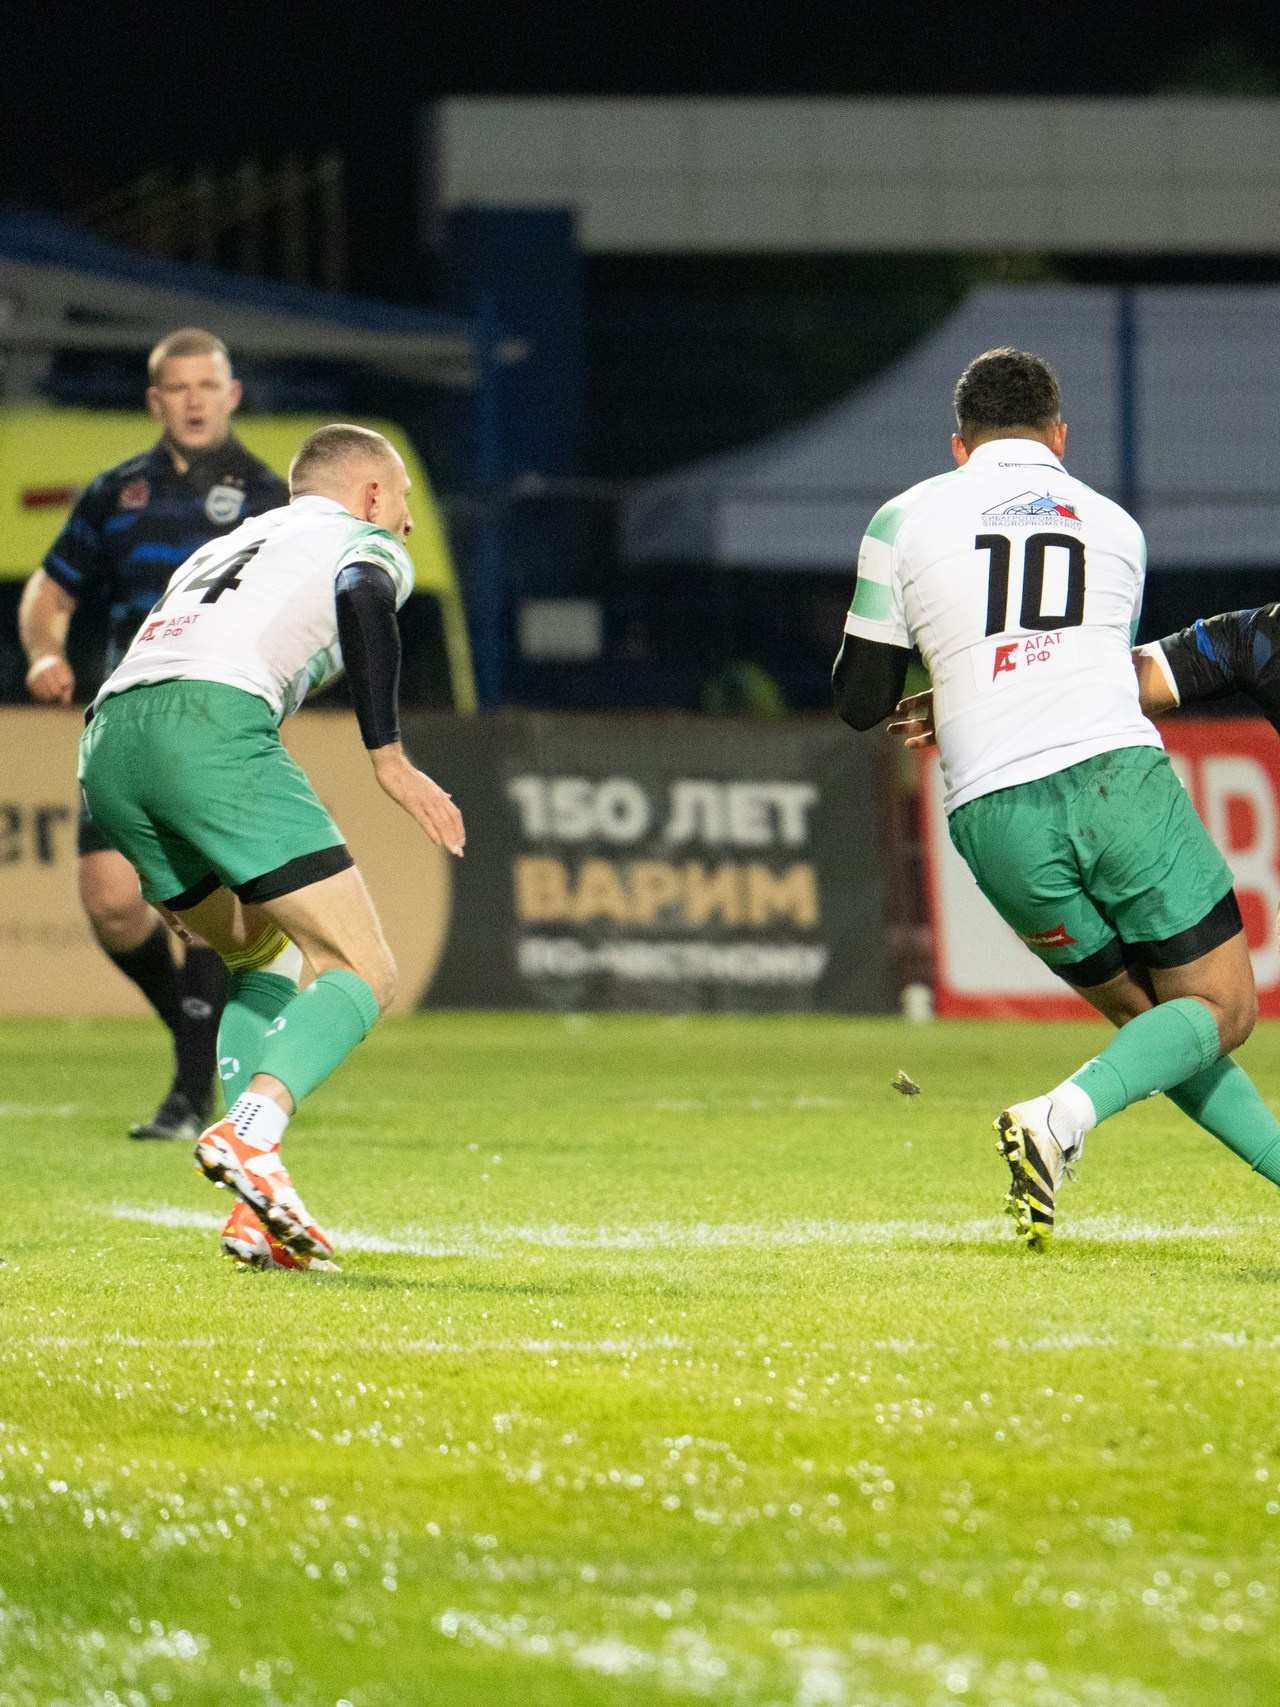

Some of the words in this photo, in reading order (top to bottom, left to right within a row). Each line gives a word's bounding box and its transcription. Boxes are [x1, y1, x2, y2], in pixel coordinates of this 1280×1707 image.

[151, 538, 267, 615] 14
[974, 532, 1086, 638] 10
[162, 628, 183, 639] РФ
[167, 614, 200, 628] АГАТ
[1024, 631, 1063, 652] АГАТ
[1026, 651, 1051, 666] РФ
[507, 776, 650, 843] 150
[664, 778, 818, 845] ЛЕТ
[514, 857, 820, 929] ВАРИМ
